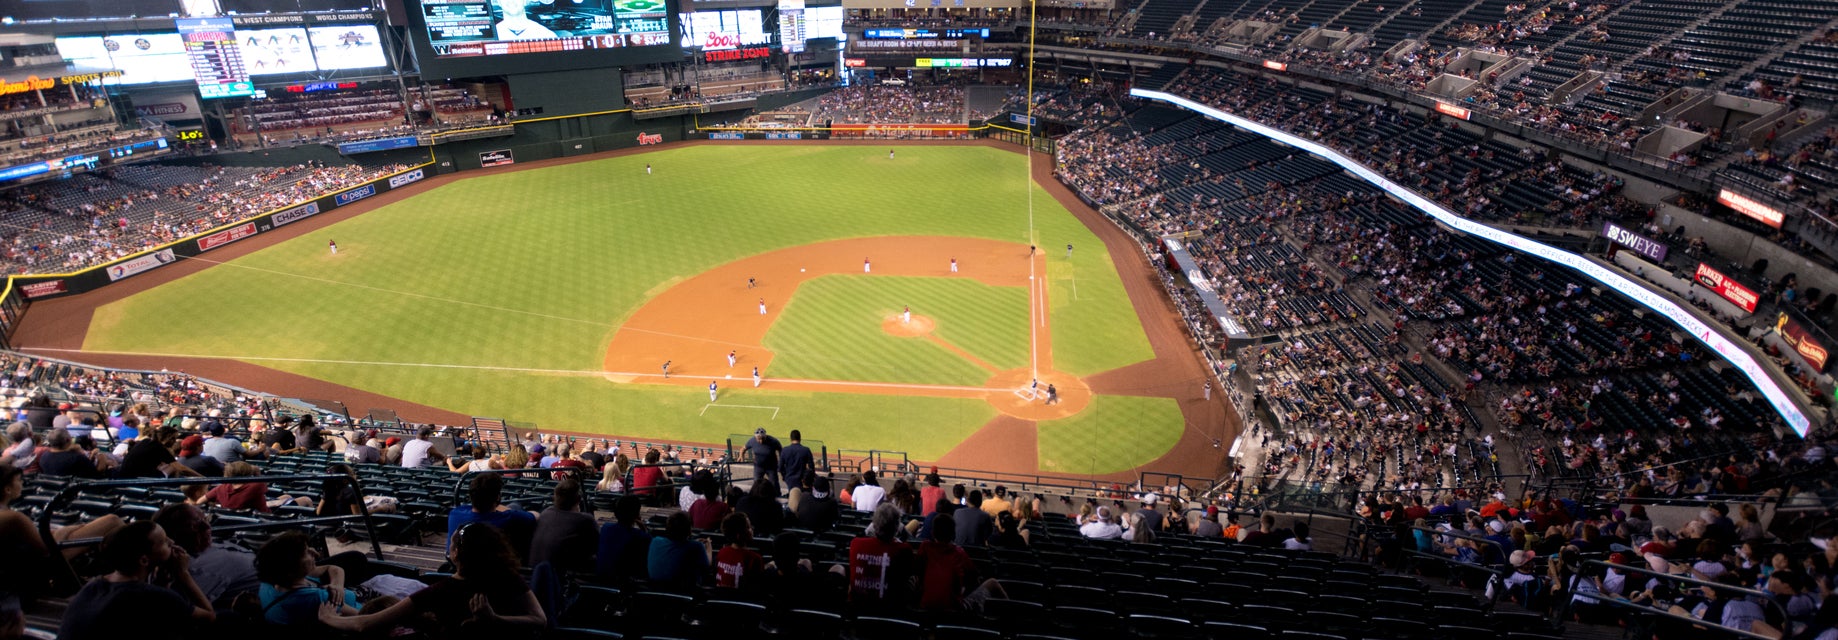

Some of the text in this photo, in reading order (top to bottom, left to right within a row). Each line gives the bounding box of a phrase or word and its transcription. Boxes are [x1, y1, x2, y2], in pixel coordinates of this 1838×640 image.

[591, 36, 598, 48] 1
[604, 35, 614, 48] 0
[620, 34, 626, 47] 1
[705, 31, 740, 47] Coors
[706, 47, 769, 62] STRIKE ZONE
[61, 73, 99, 85] SPORTS
[908, 126, 932, 136] Farm
[391, 171, 422, 186] GEICO
[350, 186, 370, 201] pepsi
[276, 208, 306, 223] CHASE
[1618, 229, 1661, 259] SWEYE
[126, 260, 149, 270] TOTAL
[1698, 263, 1723, 287] PARKER
[1540, 248, 1574, 265] OFFICIAL
[1578, 260, 1594, 272] BEER
[1595, 269, 1603, 277] OF
[1606, 273, 1617, 284] THE
[1618, 280, 1648, 301] ARIZONA
[1651, 297, 1702, 335] DIAMONDBACKS
[855, 579, 888, 590] MISSION
